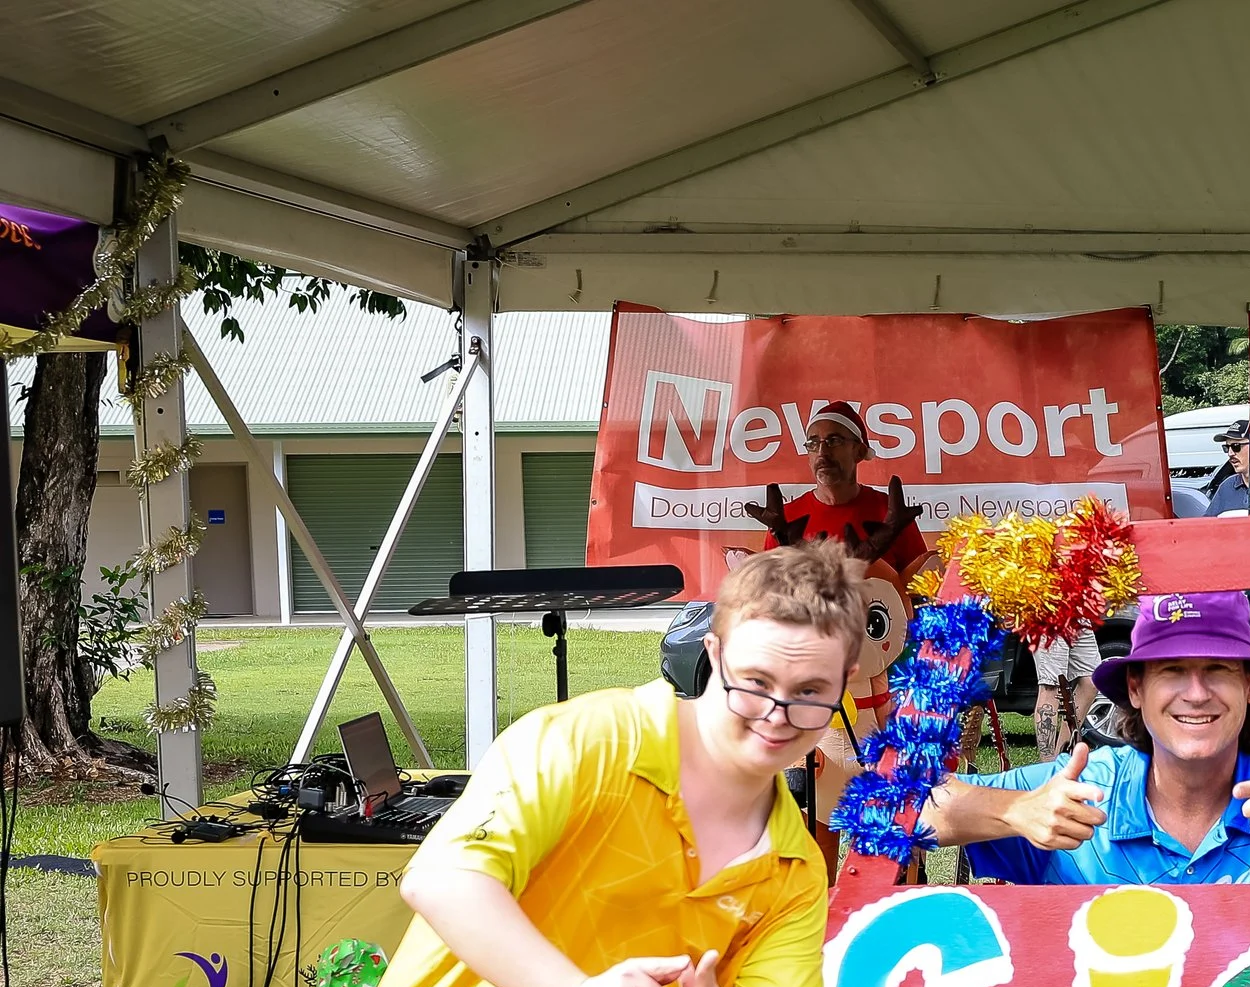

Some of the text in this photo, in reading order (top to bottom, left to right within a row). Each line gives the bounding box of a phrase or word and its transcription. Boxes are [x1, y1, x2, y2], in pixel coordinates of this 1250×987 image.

[126, 870, 403, 888] PROUDLY SUPPORTED BY
